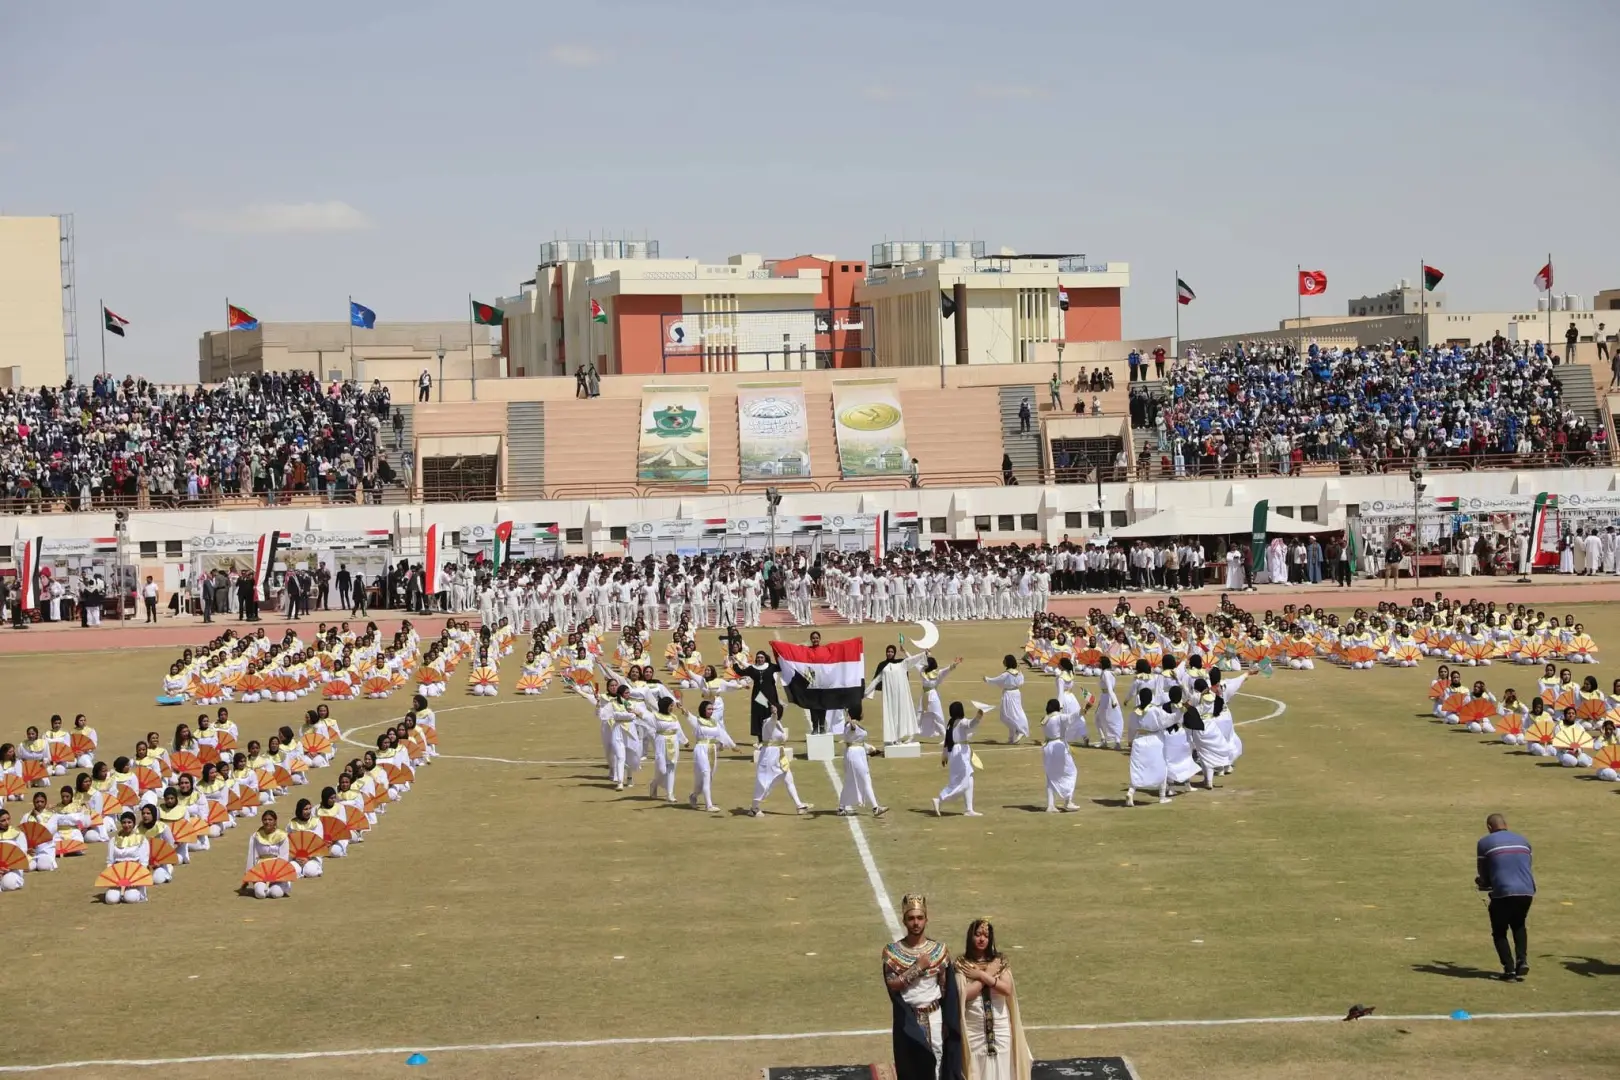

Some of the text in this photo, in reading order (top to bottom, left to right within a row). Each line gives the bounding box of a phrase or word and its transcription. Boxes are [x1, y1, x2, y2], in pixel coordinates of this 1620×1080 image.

[833, 317, 864, 331] ستاد
[1407, 501, 1433, 510] جمهوية
[1484, 499, 1504, 507] السودان
[216, 538, 235, 547] العراق
[317, 535, 364, 544] جمهورية العراق
